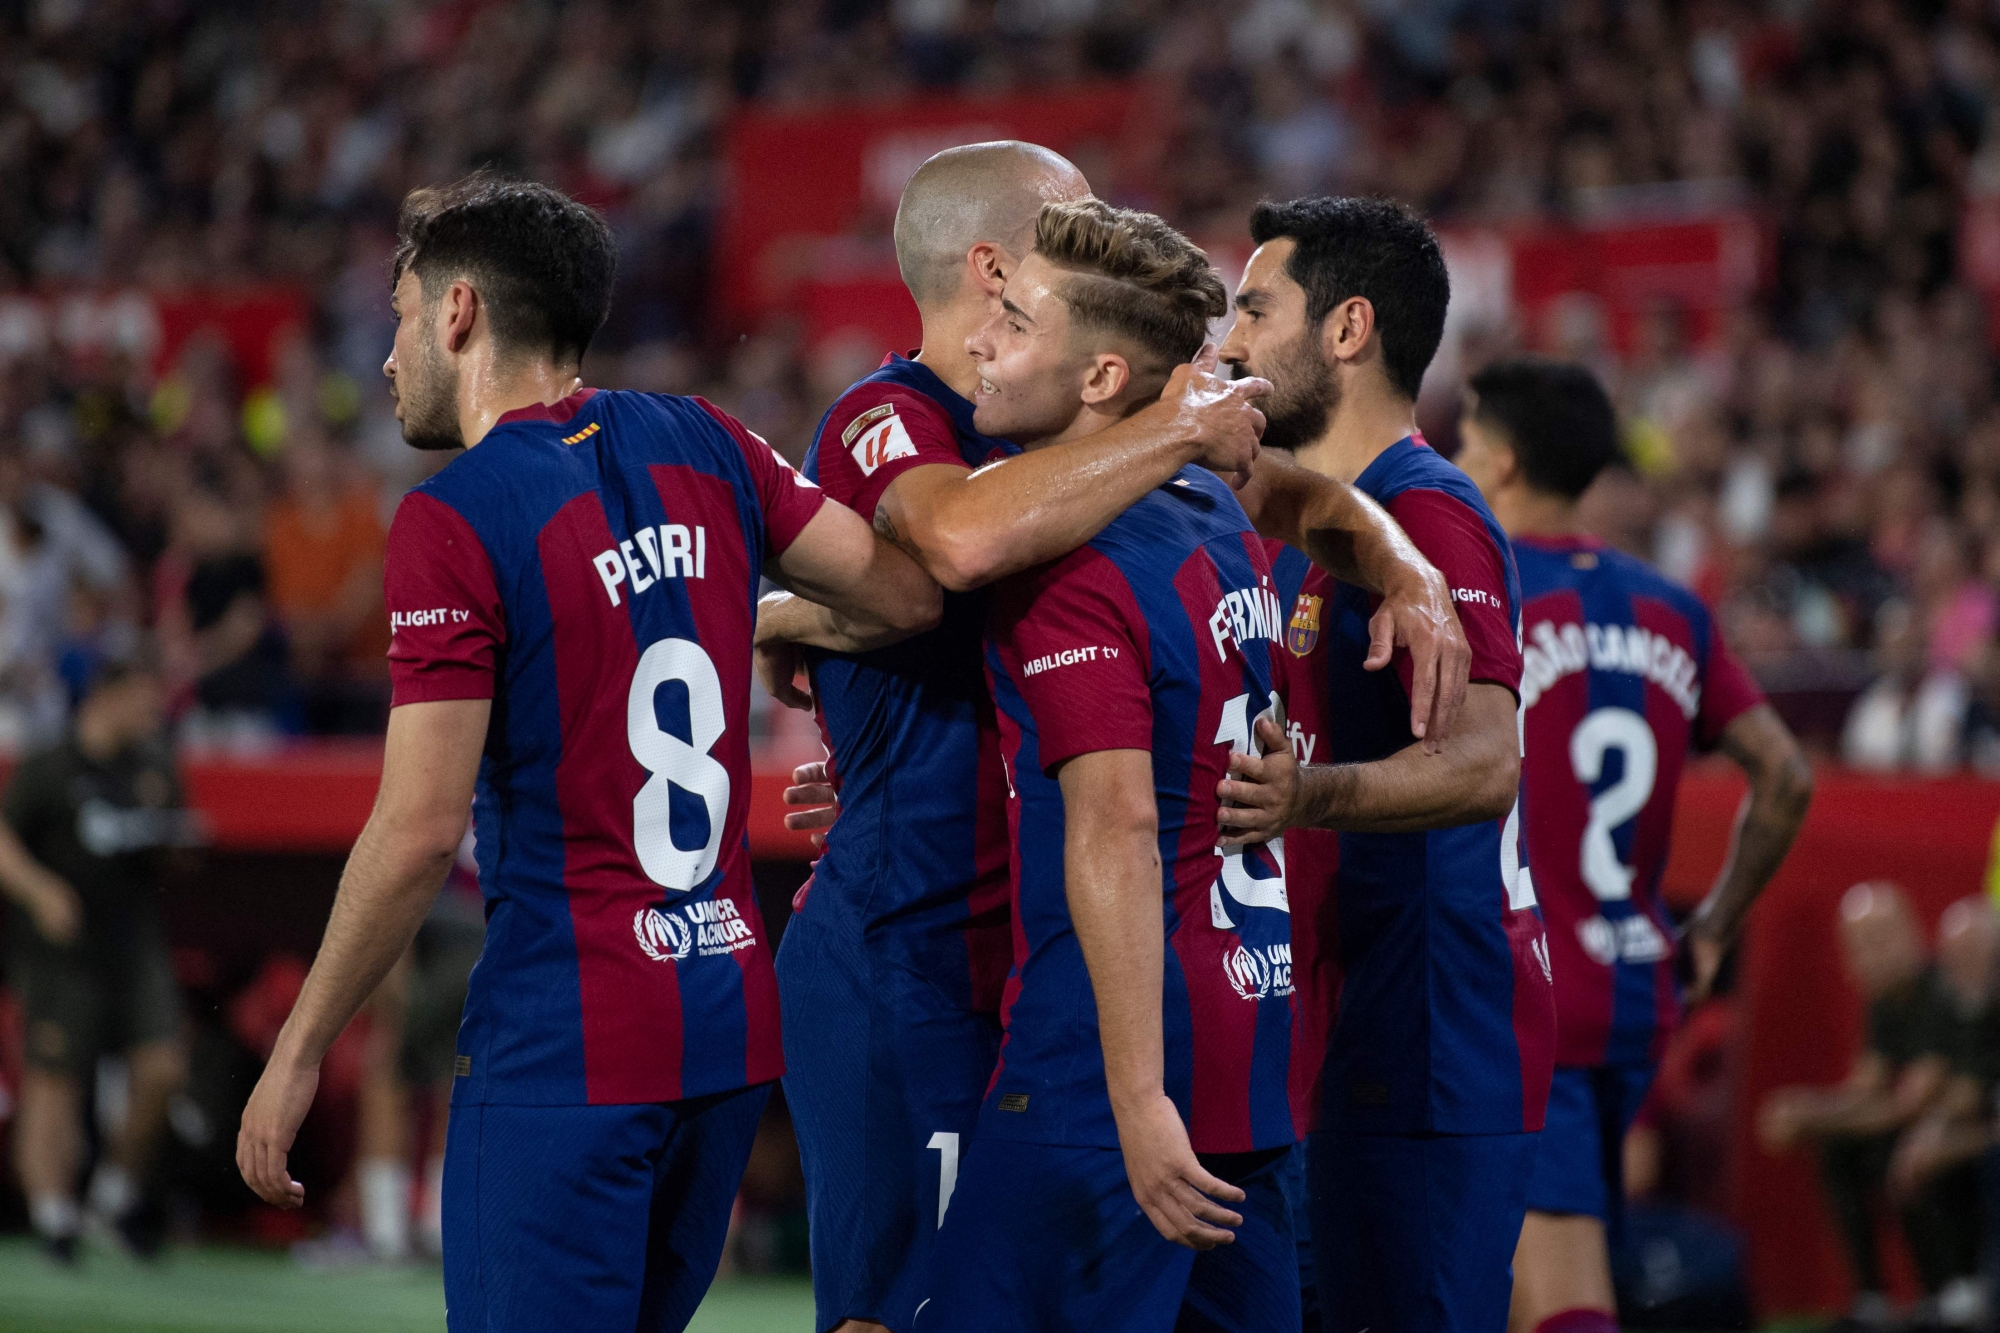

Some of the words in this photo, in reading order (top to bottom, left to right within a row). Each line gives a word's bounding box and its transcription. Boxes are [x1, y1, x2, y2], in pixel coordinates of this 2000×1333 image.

[592, 524, 706, 608] PEDRI
[451, 609, 470, 623] tv
[1490, 594, 1501, 609] tv
[1208, 574, 1284, 664] FERMÍN
[1023, 646, 1098, 678] MBILIGHT
[1102, 646, 1119, 659] tv
[626, 637, 730, 892] 8
[1569, 705, 1658, 901] 2
[697, 918, 753, 947] ACNUR
[698, 948, 708, 957] The
[733, 938, 756, 950] Agency
